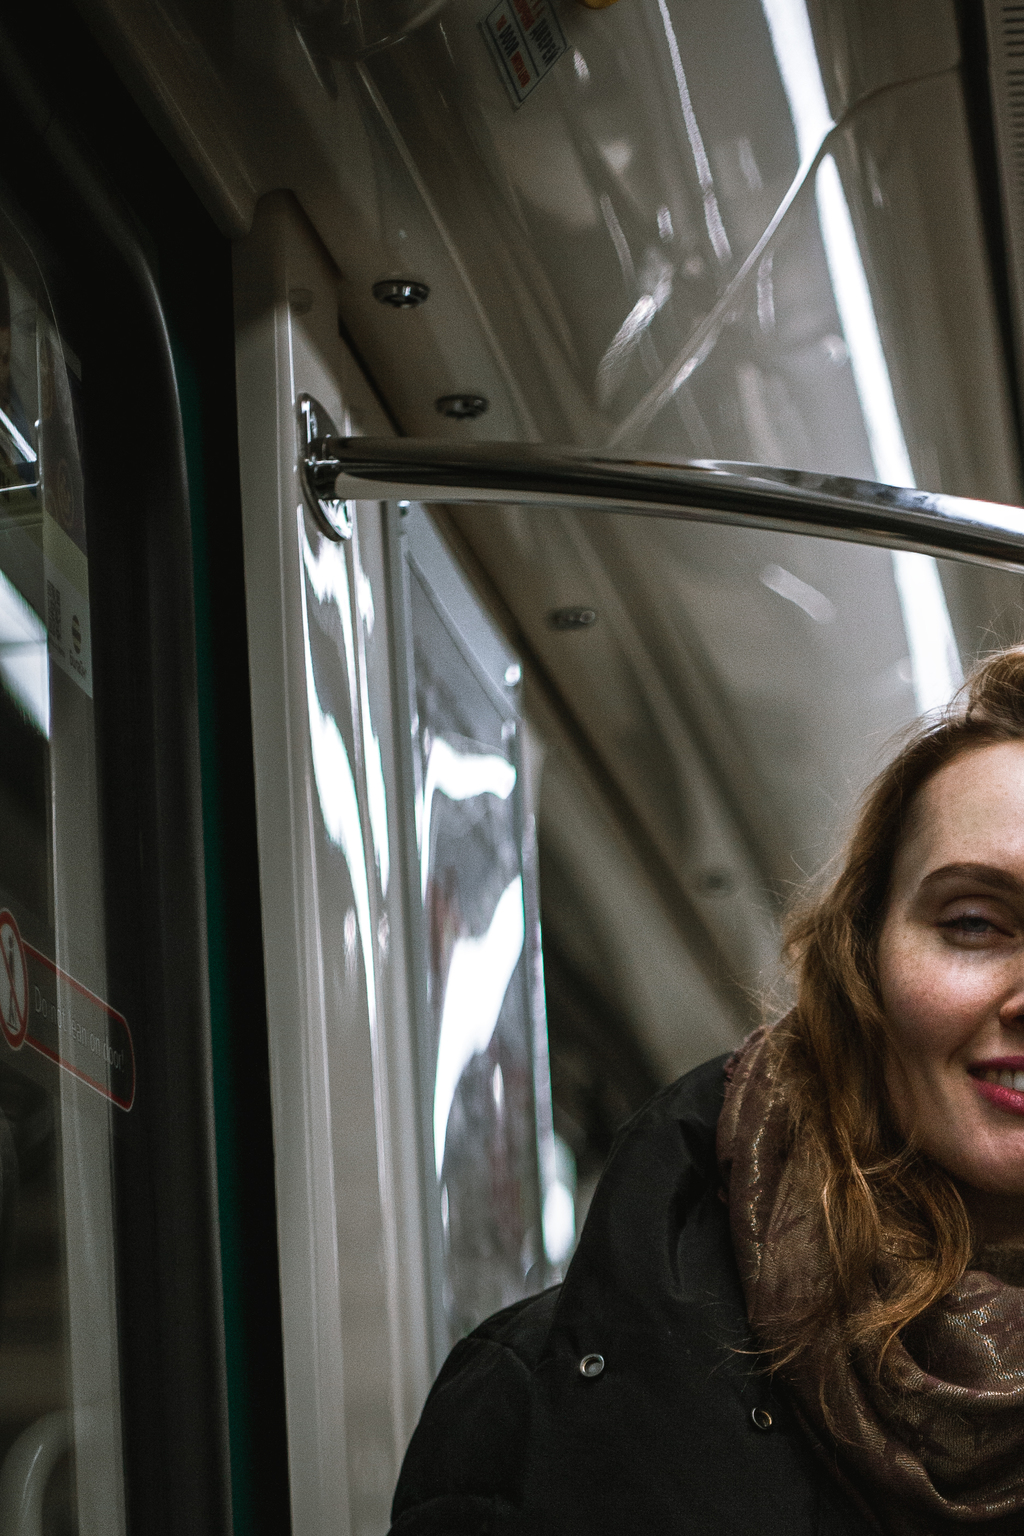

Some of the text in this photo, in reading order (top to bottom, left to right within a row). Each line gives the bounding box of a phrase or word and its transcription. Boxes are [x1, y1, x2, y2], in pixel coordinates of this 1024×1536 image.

[499, 23, 520, 58] DOOR
[529, 18, 560, 67] ДВЕРЕЙ
[34, 985, 125, 1072] Do not lean on door!
